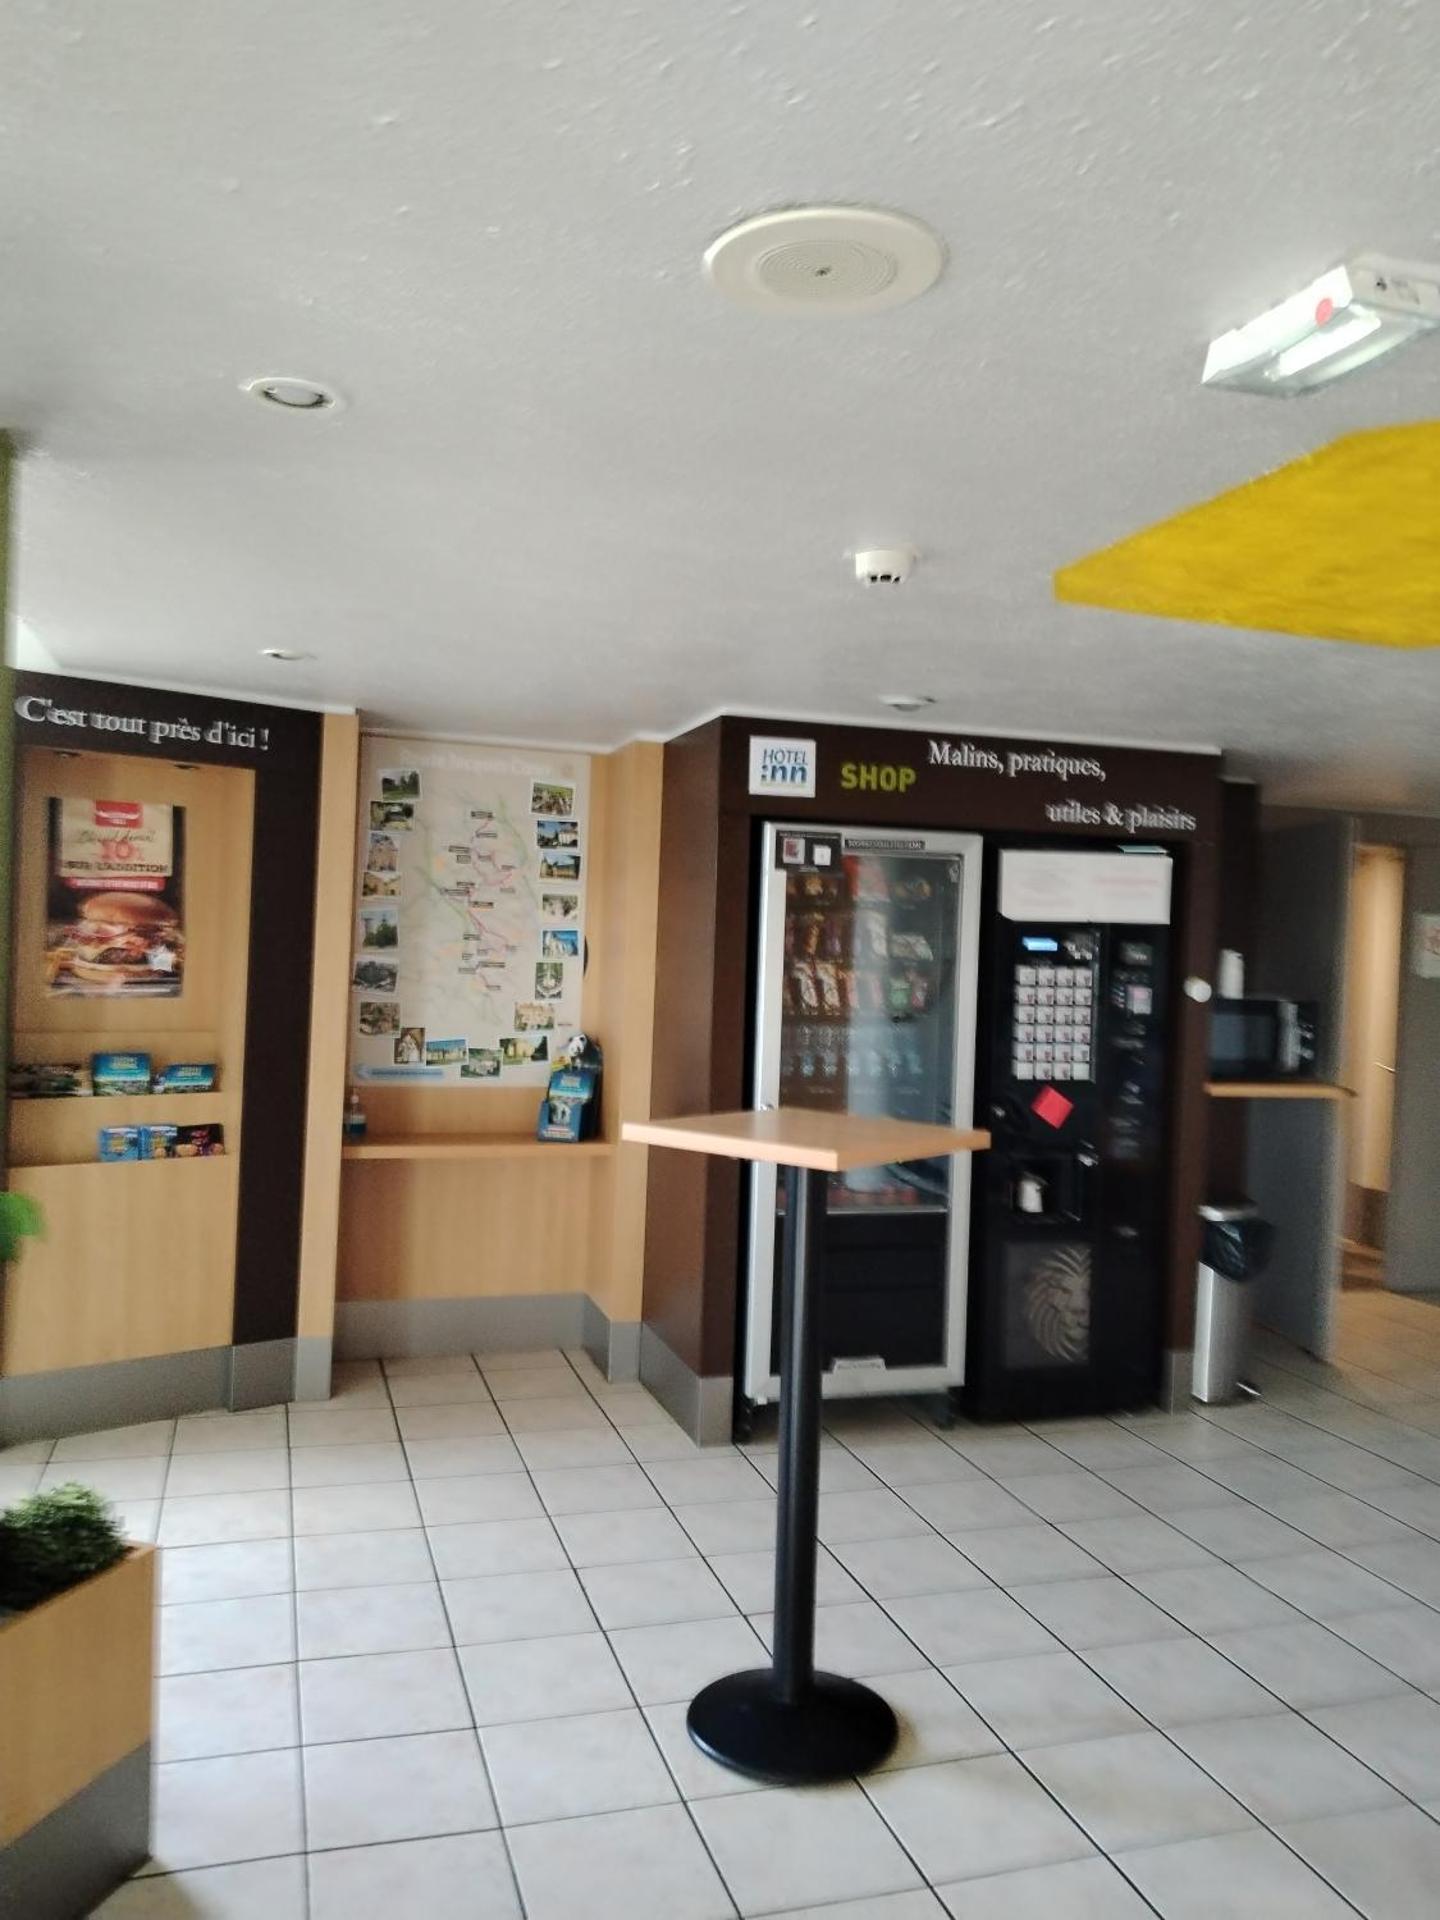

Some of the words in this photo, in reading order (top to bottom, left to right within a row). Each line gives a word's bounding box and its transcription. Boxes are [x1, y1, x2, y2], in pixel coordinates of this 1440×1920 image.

[14, 695, 88, 727] C'est
[91, 713, 147, 734] tout
[150, 717, 201, 744] près
[204, 720, 256, 748] d'ici
[762, 748, 808, 766] HOTEL
[928, 739, 1004, 774] Malins,
[1007, 749, 1107, 781] pratiques,
[840, 761, 917, 792] SHOP
[1045, 799, 1101, 825] utiles
[1101, 801, 1124, 826] &
[1124, 803, 1198, 834] plaisirs
